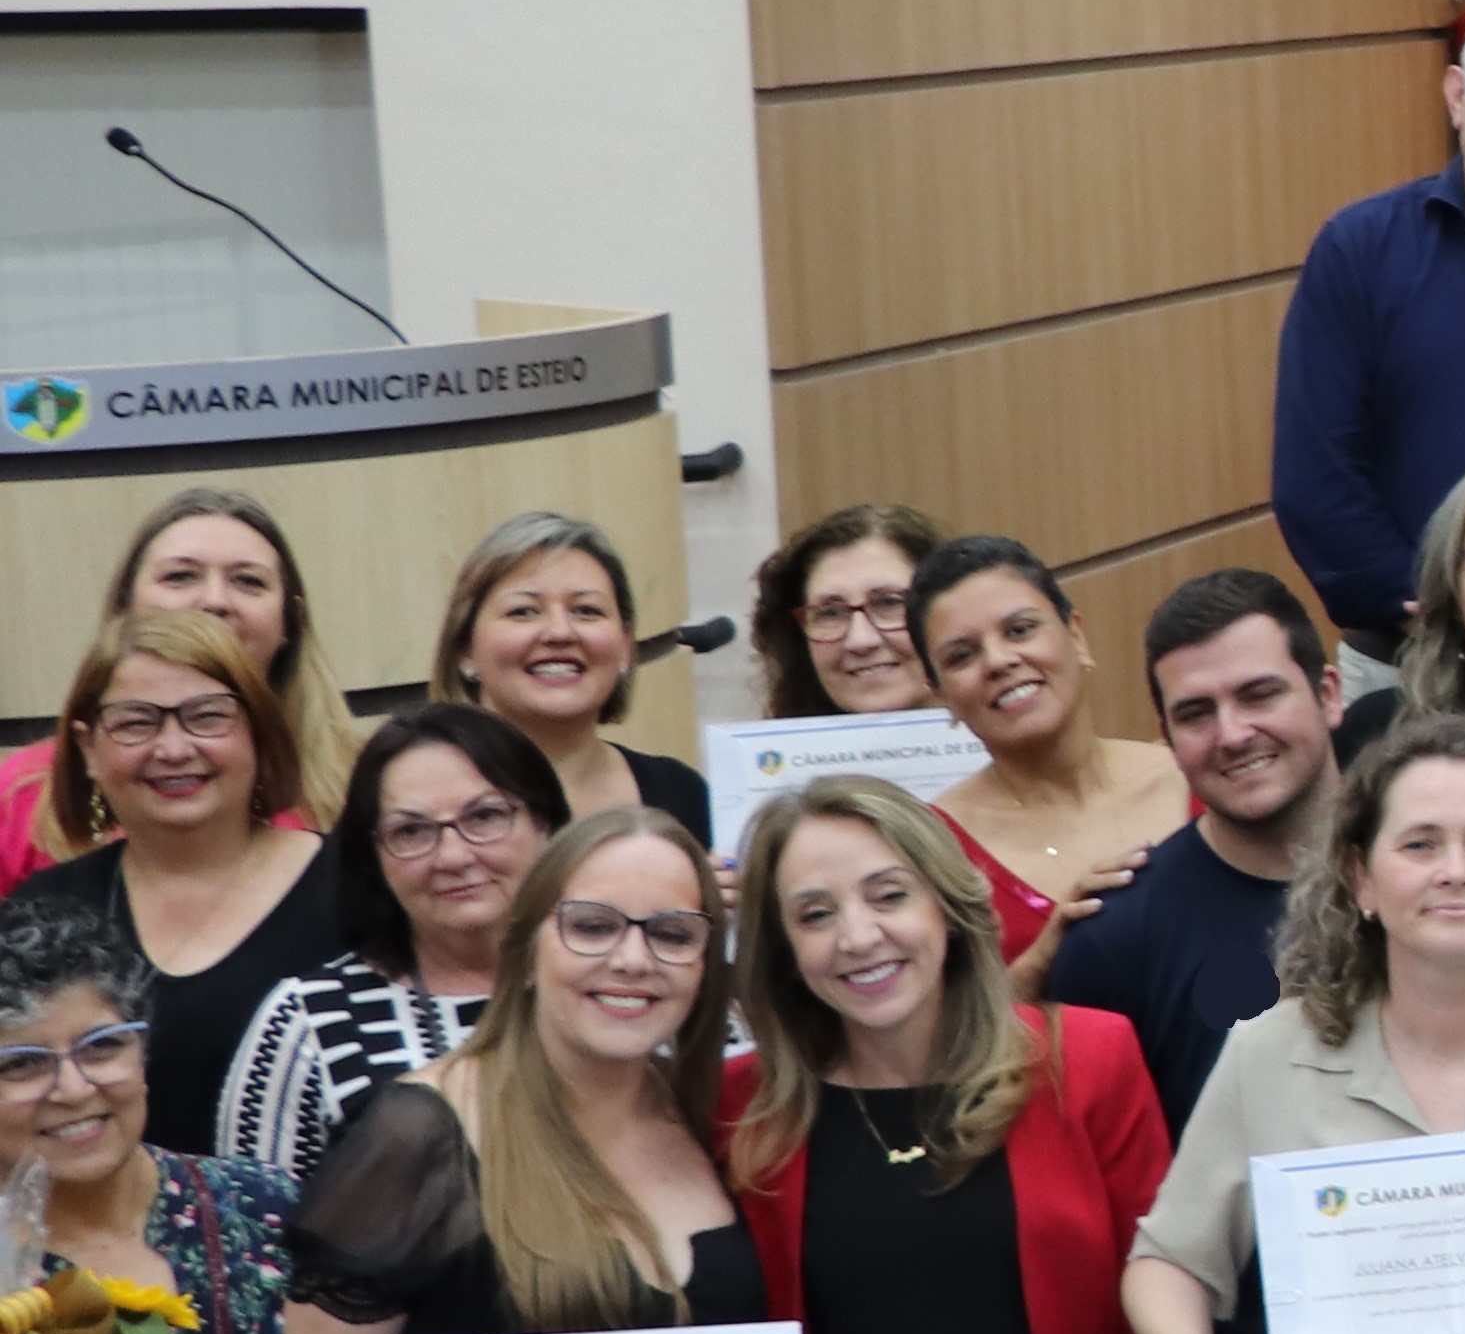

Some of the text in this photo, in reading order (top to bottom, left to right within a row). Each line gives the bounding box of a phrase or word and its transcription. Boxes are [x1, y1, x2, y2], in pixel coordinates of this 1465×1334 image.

[106, 357, 588, 420] CÂMARA MUNICIPAL DE ESTEIO
[790, 746, 856, 770] CÂMARA
[859, 741, 941, 764] MUNICIPAL
[944, 741, 963, 755] DE
[1355, 1182, 1433, 1207] CÂMARA
[1353, 1256, 1416, 1277] JULIANA
